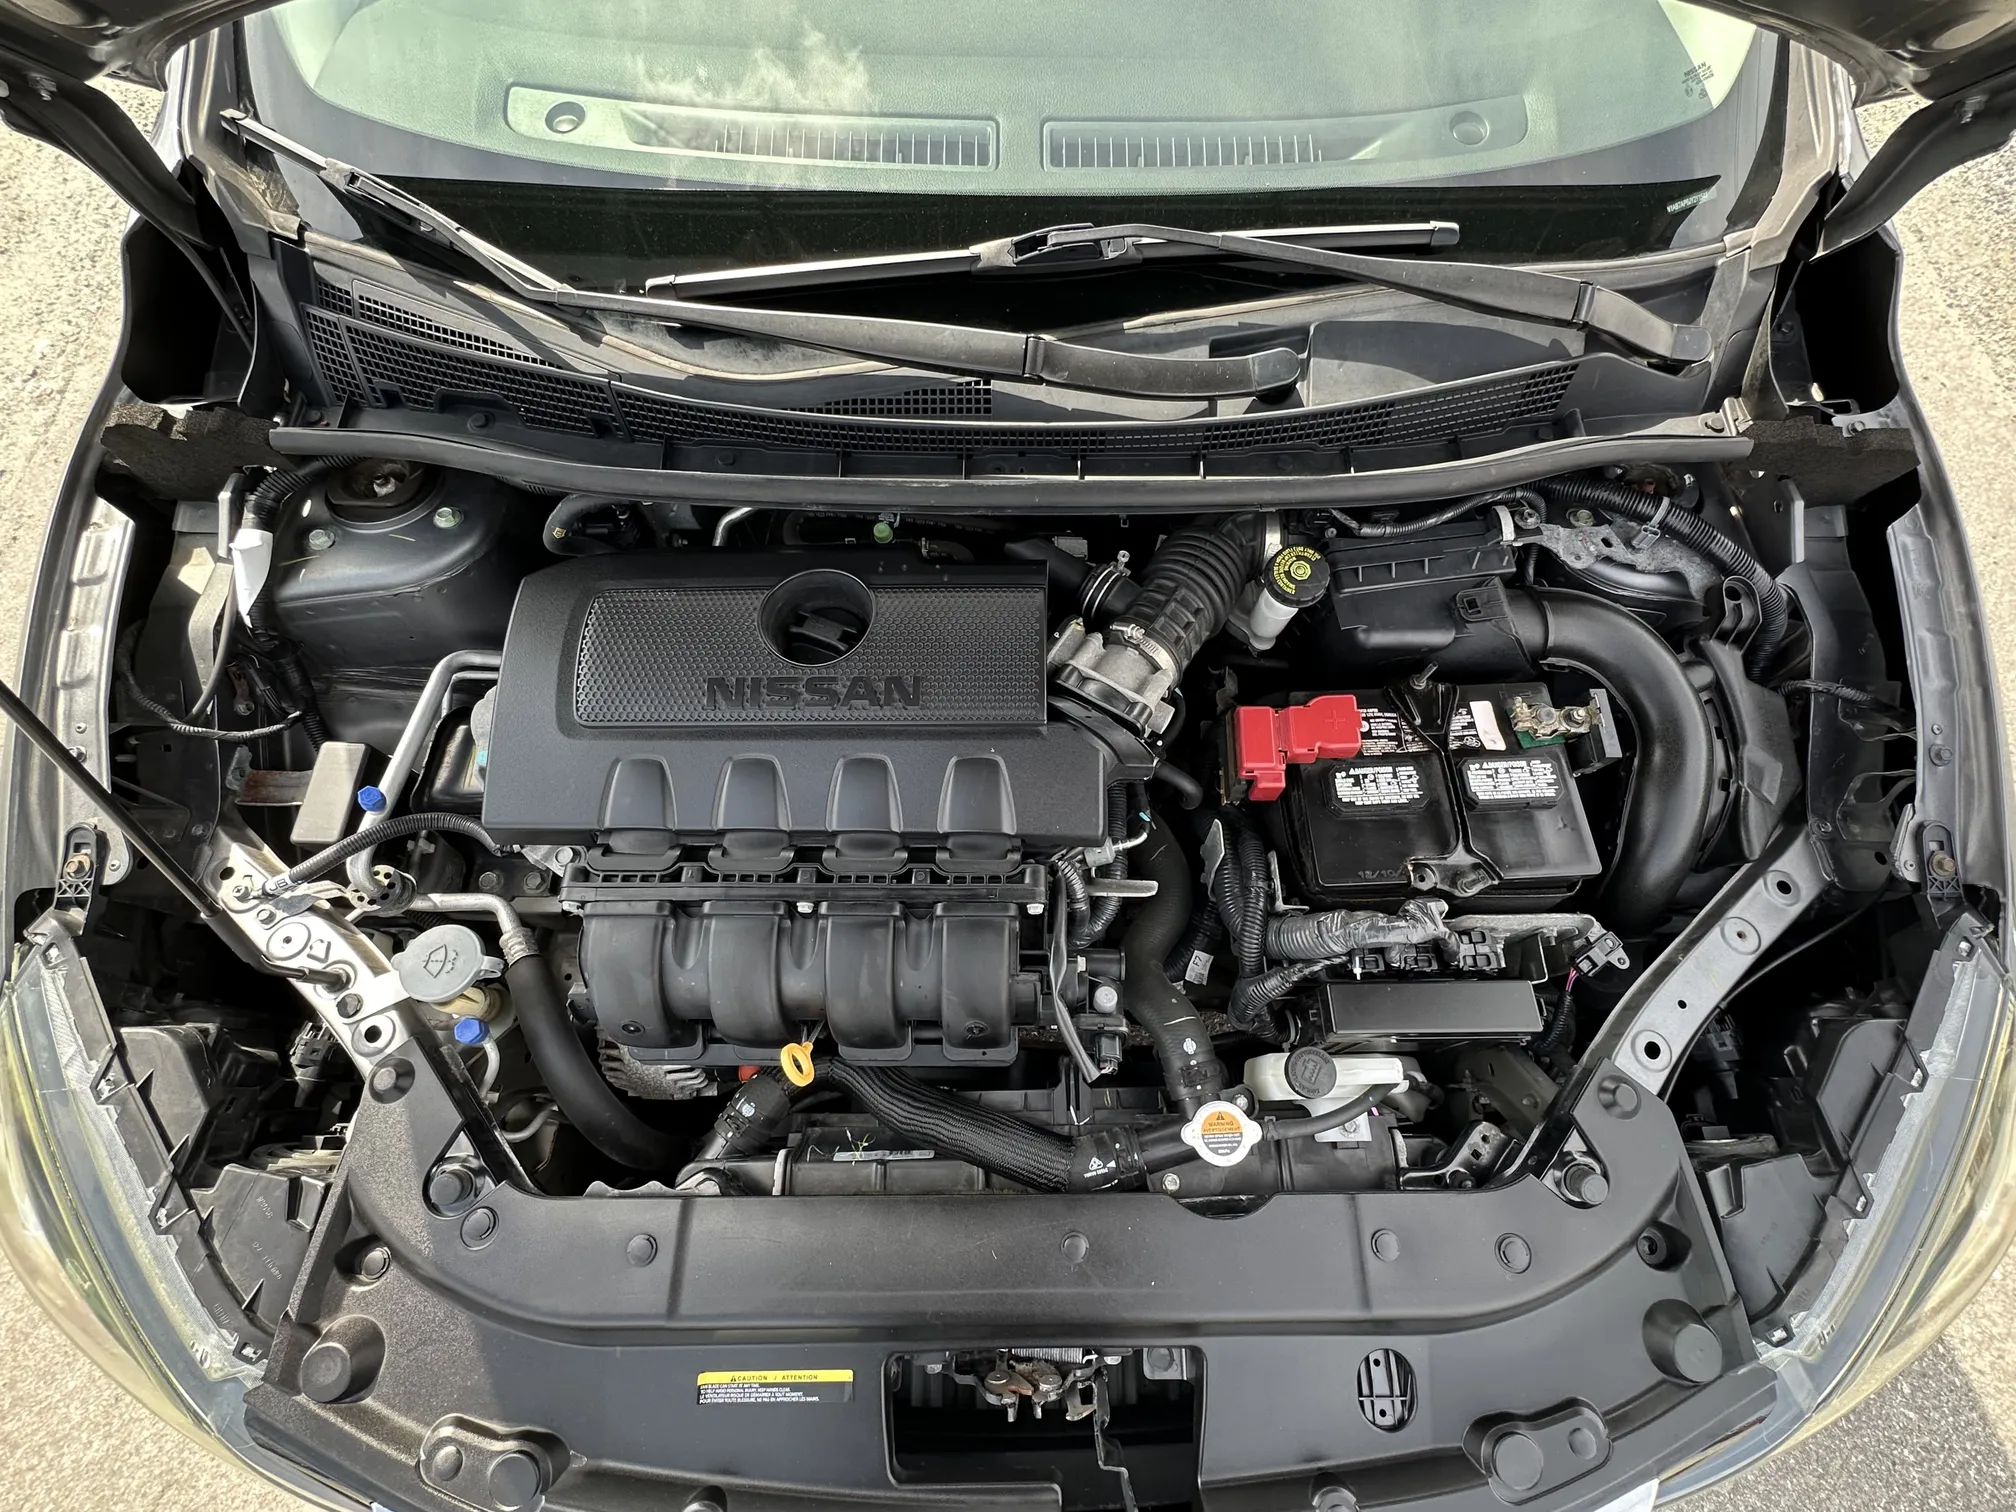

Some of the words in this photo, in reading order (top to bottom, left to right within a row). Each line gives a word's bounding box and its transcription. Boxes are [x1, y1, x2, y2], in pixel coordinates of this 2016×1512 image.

[1684, 61, 1707, 77] NISSAN
[705, 675, 921, 708] NISSAN
[269, 878, 288, 891] JB
[1192, 955, 1202, 967] F7
